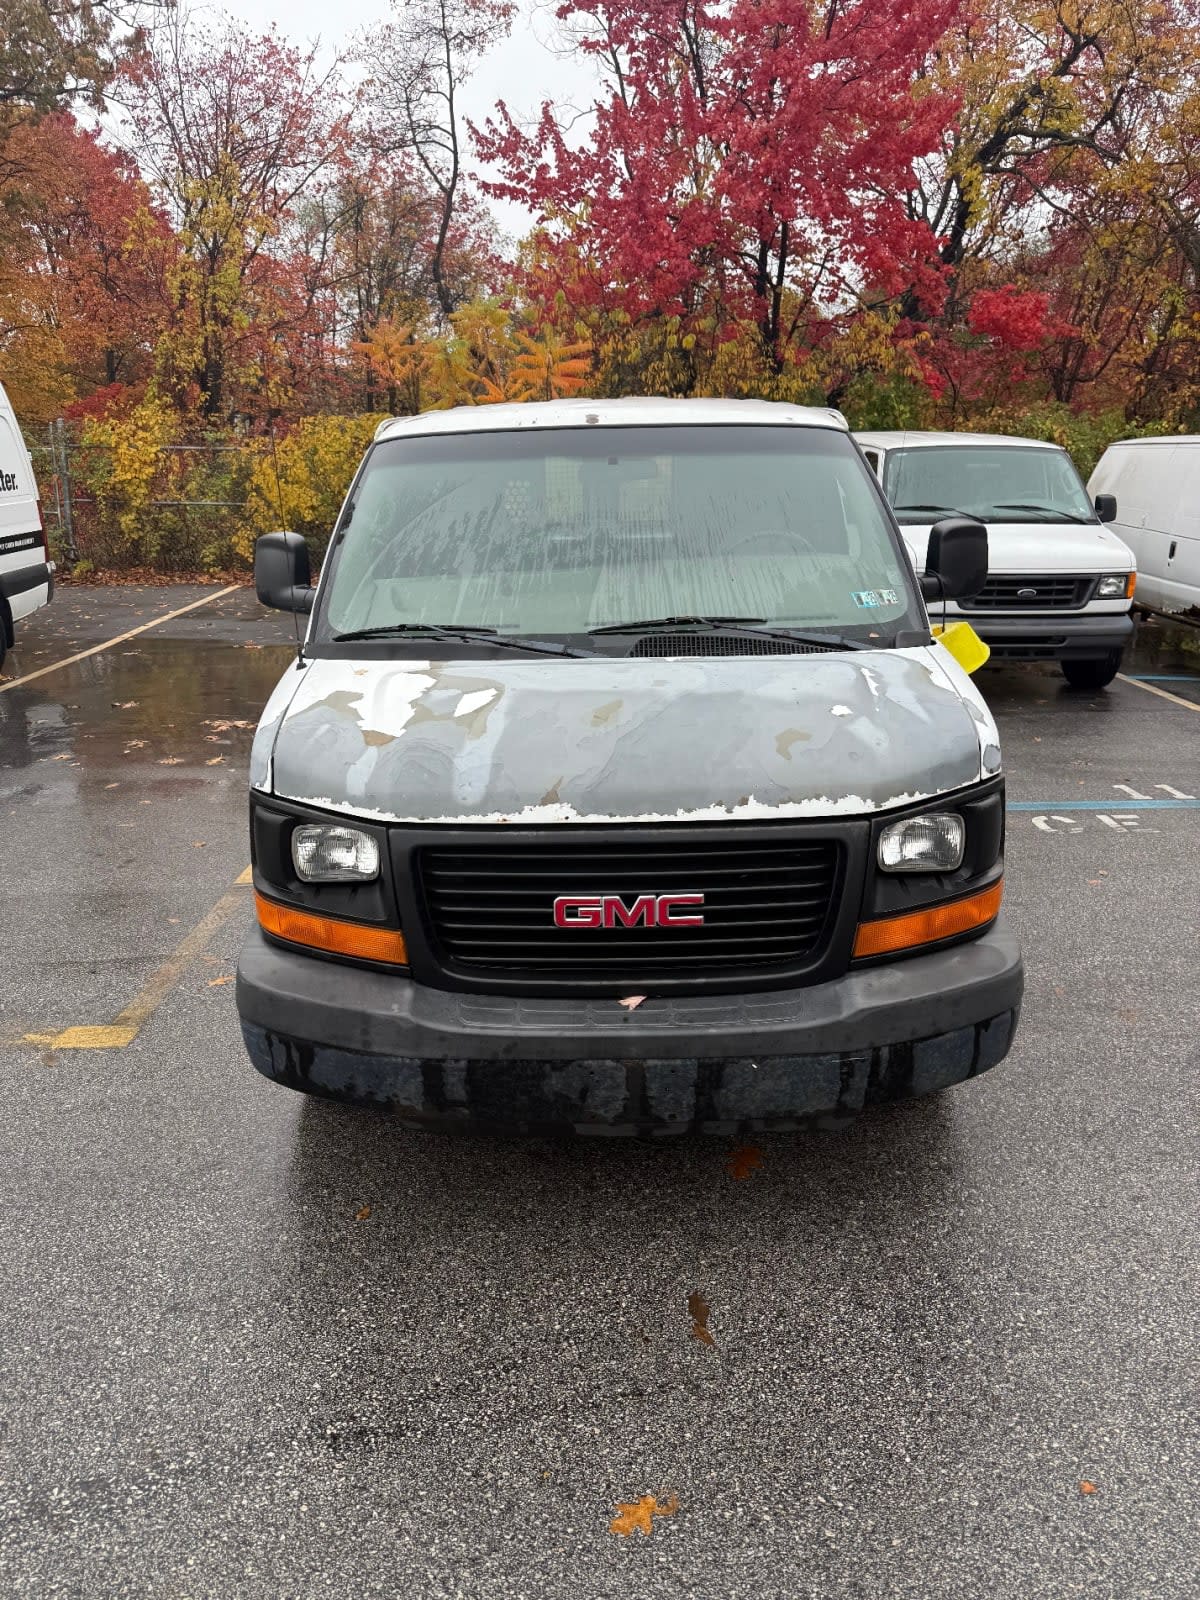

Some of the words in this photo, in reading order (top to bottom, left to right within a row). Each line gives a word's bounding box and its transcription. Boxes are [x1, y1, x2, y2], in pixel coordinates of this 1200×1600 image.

[0, 469, 18, 492] ter.
[1112, 784, 1196, 799] 11
[553, 893, 704, 928] GMC
